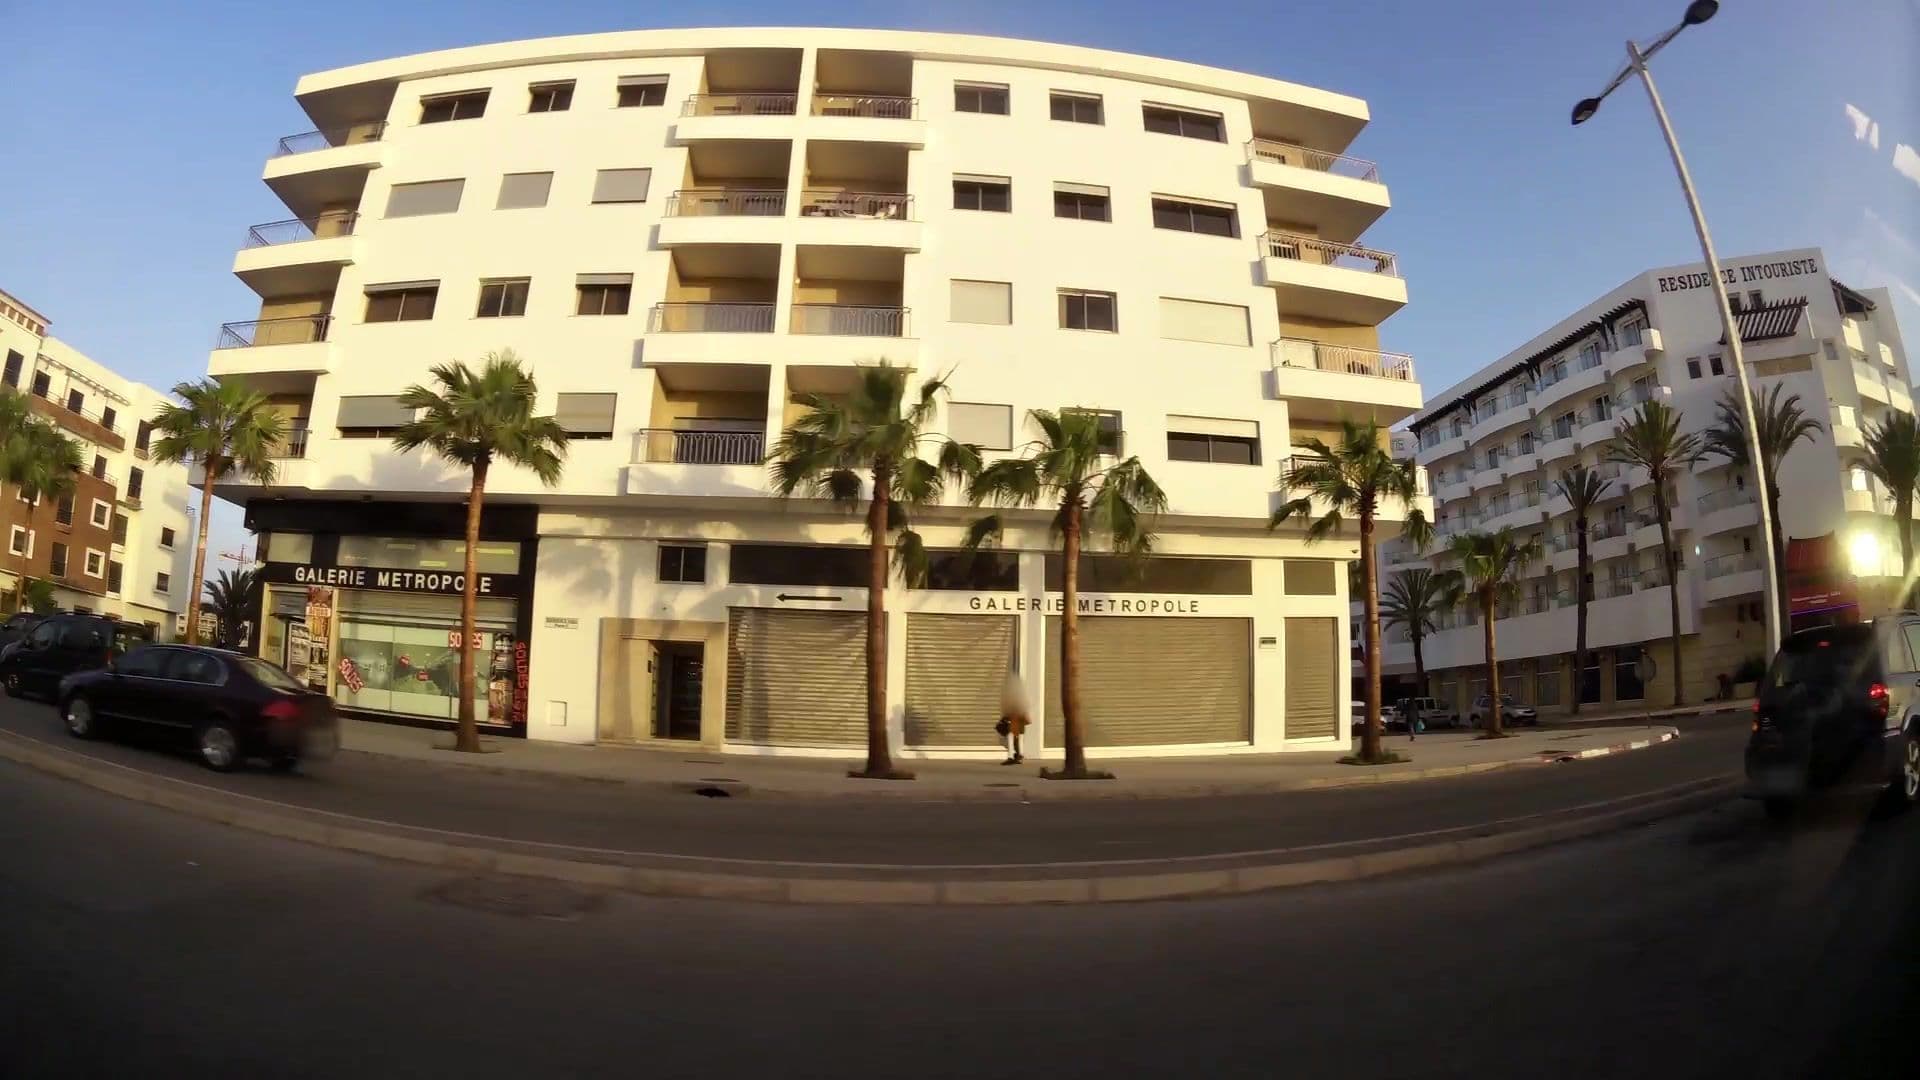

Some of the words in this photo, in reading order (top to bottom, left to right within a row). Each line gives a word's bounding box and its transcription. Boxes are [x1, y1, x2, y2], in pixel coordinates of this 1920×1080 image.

[1658, 268, 1737, 293] RESIDECE
[1740, 258, 1818, 283] INTOURISTE
[295, 566, 366, 586] GALERIE
[377, 571, 492, 593] METROPOE
[969, 596, 1065, 612] GALERIE
[1078, 599, 1199, 613] METROPOLE
